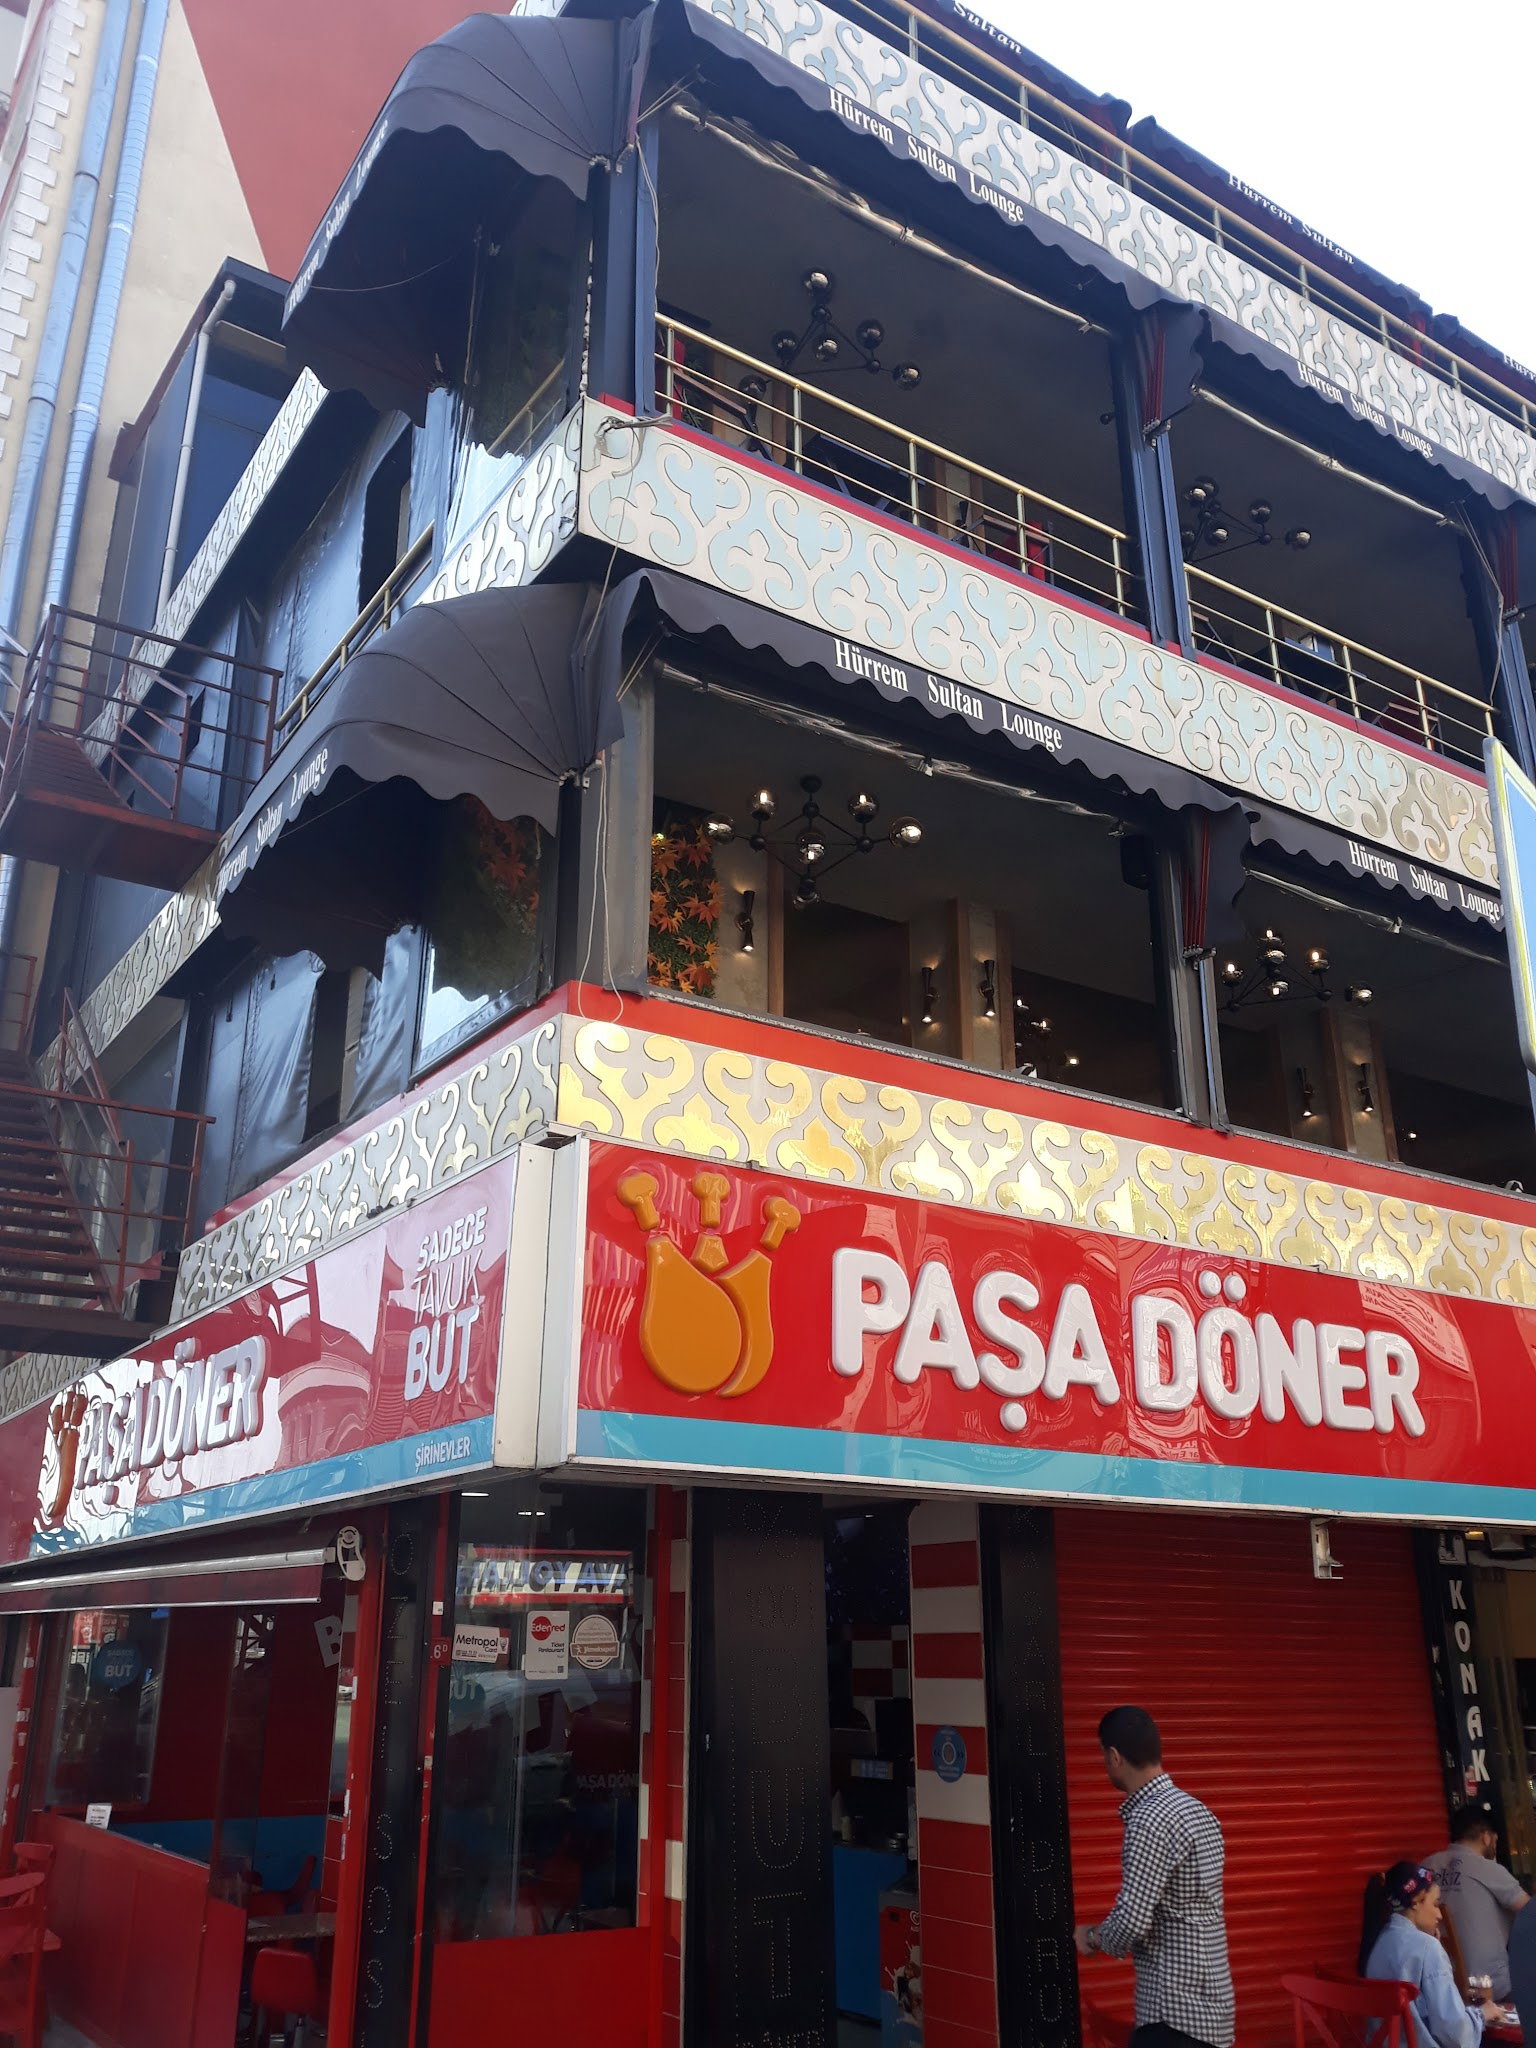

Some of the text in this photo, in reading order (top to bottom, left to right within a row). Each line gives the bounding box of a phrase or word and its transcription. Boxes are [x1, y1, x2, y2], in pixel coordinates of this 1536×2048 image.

[953, 0, 1022, 54] Sultan
[829, 87, 1024, 223] Hürrem Sultan Lounge
[1302, 222, 1354, 265] Sultan
[1298, 361, 1434, 458] Hürrem Sultan Lounge
[832, 637, 1063, 753] Hürrem Sultan Lounge
[255, 802, 283, 852] Sultan
[290, 748, 328, 808] Lounge
[1347, 839, 1501, 924] Hürrem Sultan Lounge
[416, 1205, 489, 1272] SADECE
[414, 1249, 483, 1324] TAVUK
[404, 1304, 480, 1401] BUT
[832, 1247, 1427, 1439] PAŞA DÖNER
[73, 1337, 269, 1505] PAŞA DÖNER
[414, 1436, 471, 1474] ŞİRİNEVLER
[455, 1633, 499, 1648] Metropol
[531, 1623, 566, 1633] Edenred
[1448, 1579, 1491, 1782] KONAK
